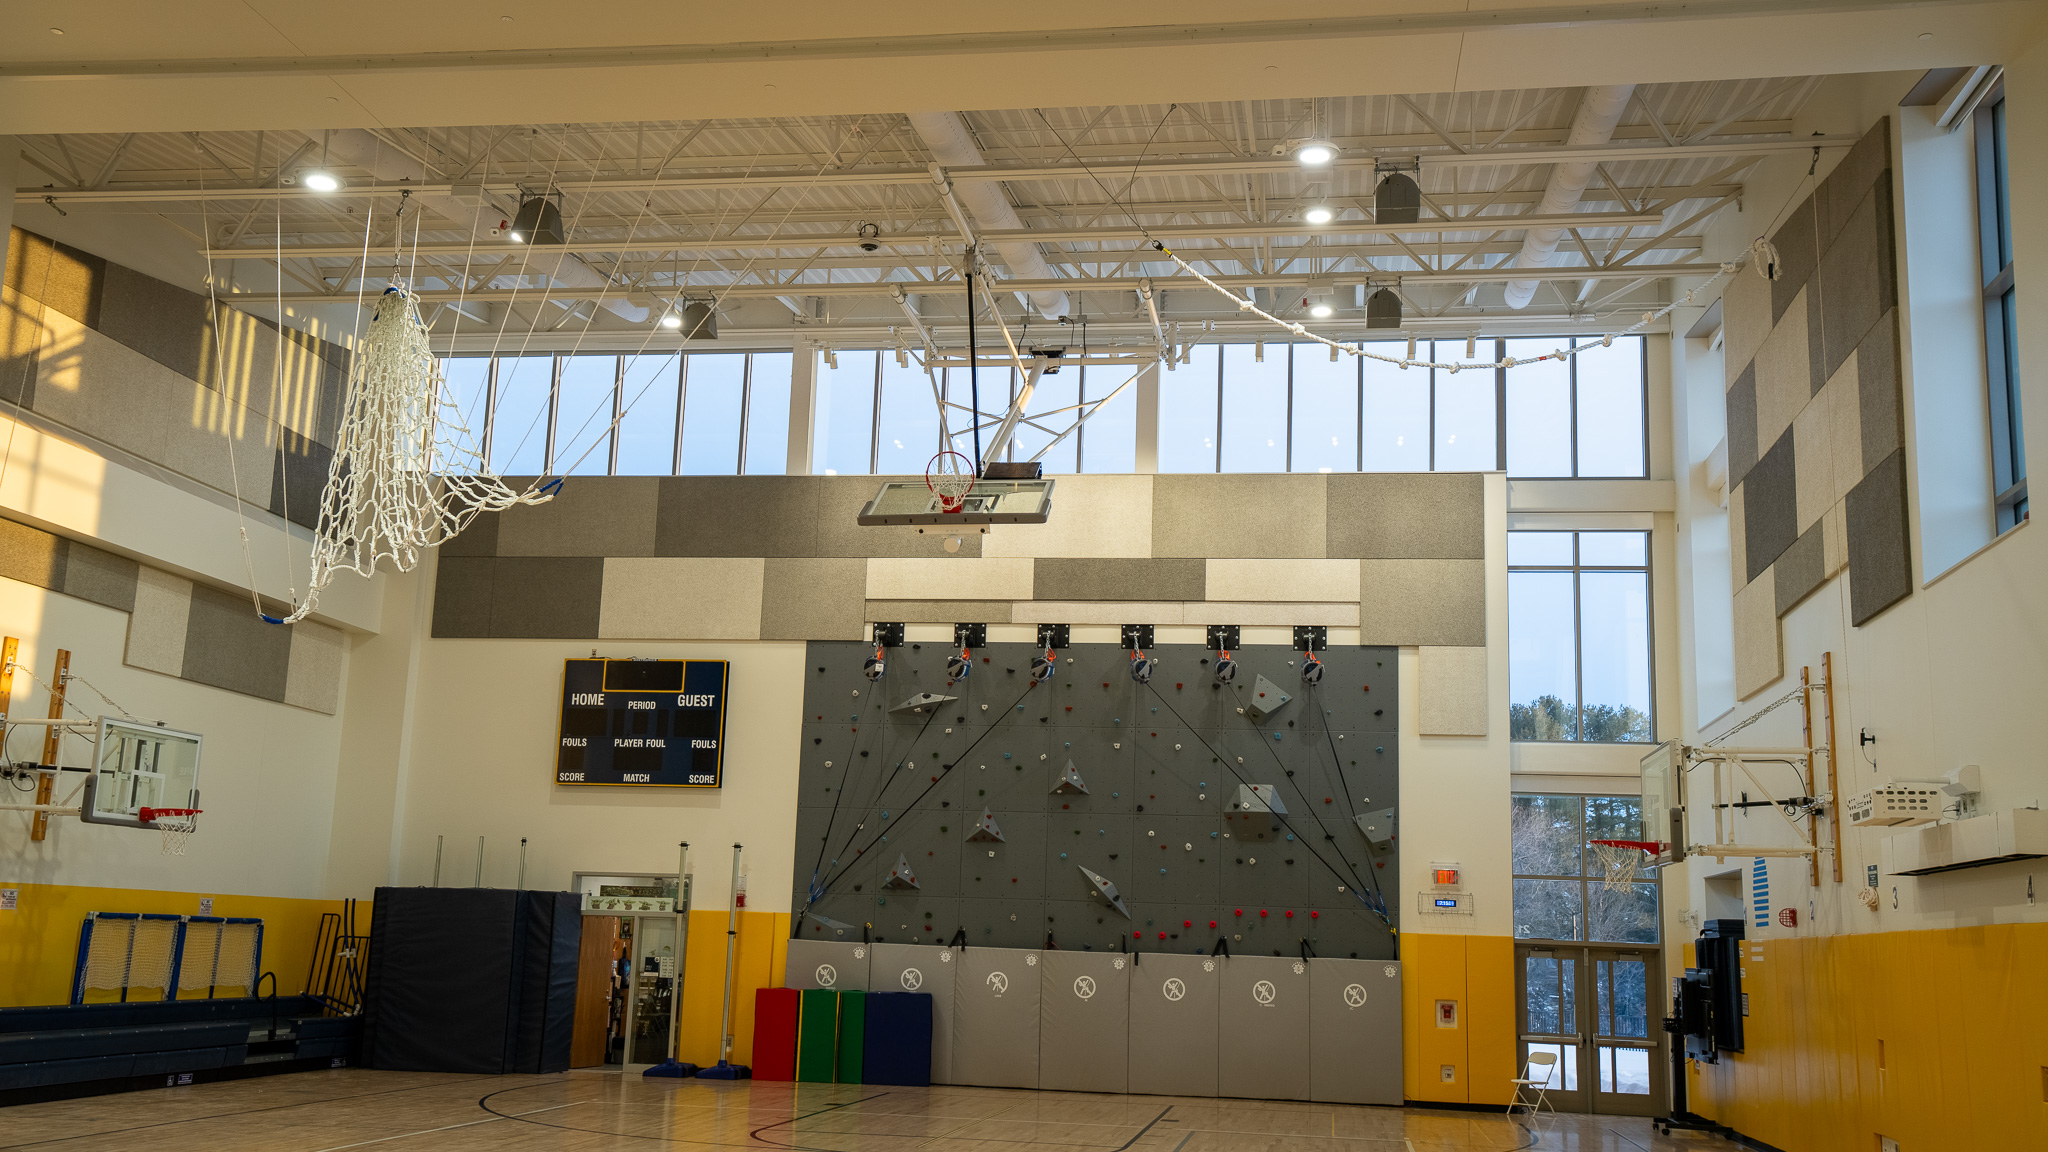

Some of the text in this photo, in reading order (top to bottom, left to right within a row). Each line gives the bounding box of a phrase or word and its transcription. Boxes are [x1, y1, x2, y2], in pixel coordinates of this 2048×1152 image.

[572, 693, 604, 706] HOME
[678, 694, 715, 707] GUEST
[628, 701, 656, 710] PERIOD
[562, 738, 587, 747] FOULS
[614, 738, 666, 748] PLAYER FOUL
[691, 740, 717, 749] FOULS
[559, 772, 585, 782] SCORE
[623, 773, 650, 783] MATCH
[689, 774, 715, 784] SCORE
[2027, 875, 2034, 904] 4
[1892, 886, 1899, 909] 3
